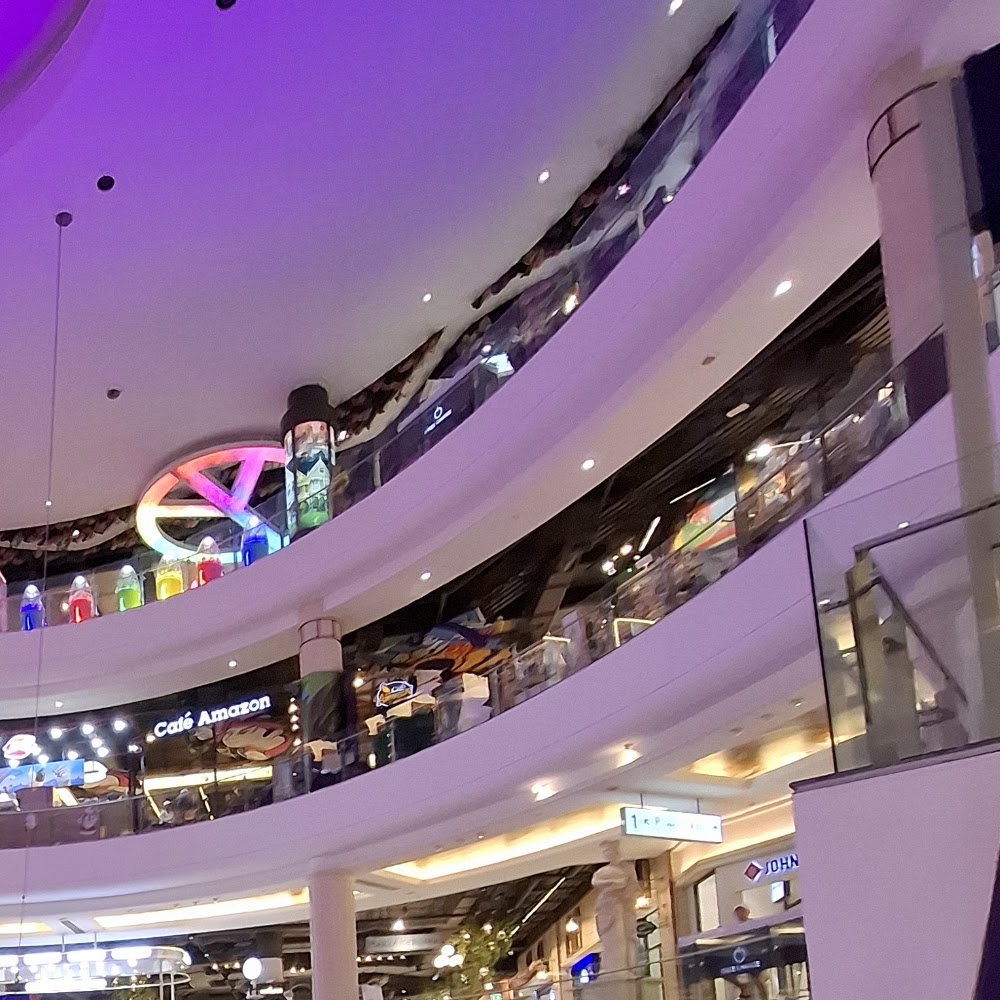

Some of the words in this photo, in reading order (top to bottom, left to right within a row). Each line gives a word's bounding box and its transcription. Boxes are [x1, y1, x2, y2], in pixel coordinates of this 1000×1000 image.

[154, 711, 194, 737] Café
[198, 696, 271, 726] Amazon
[765, 853, 799, 875] JOHN
